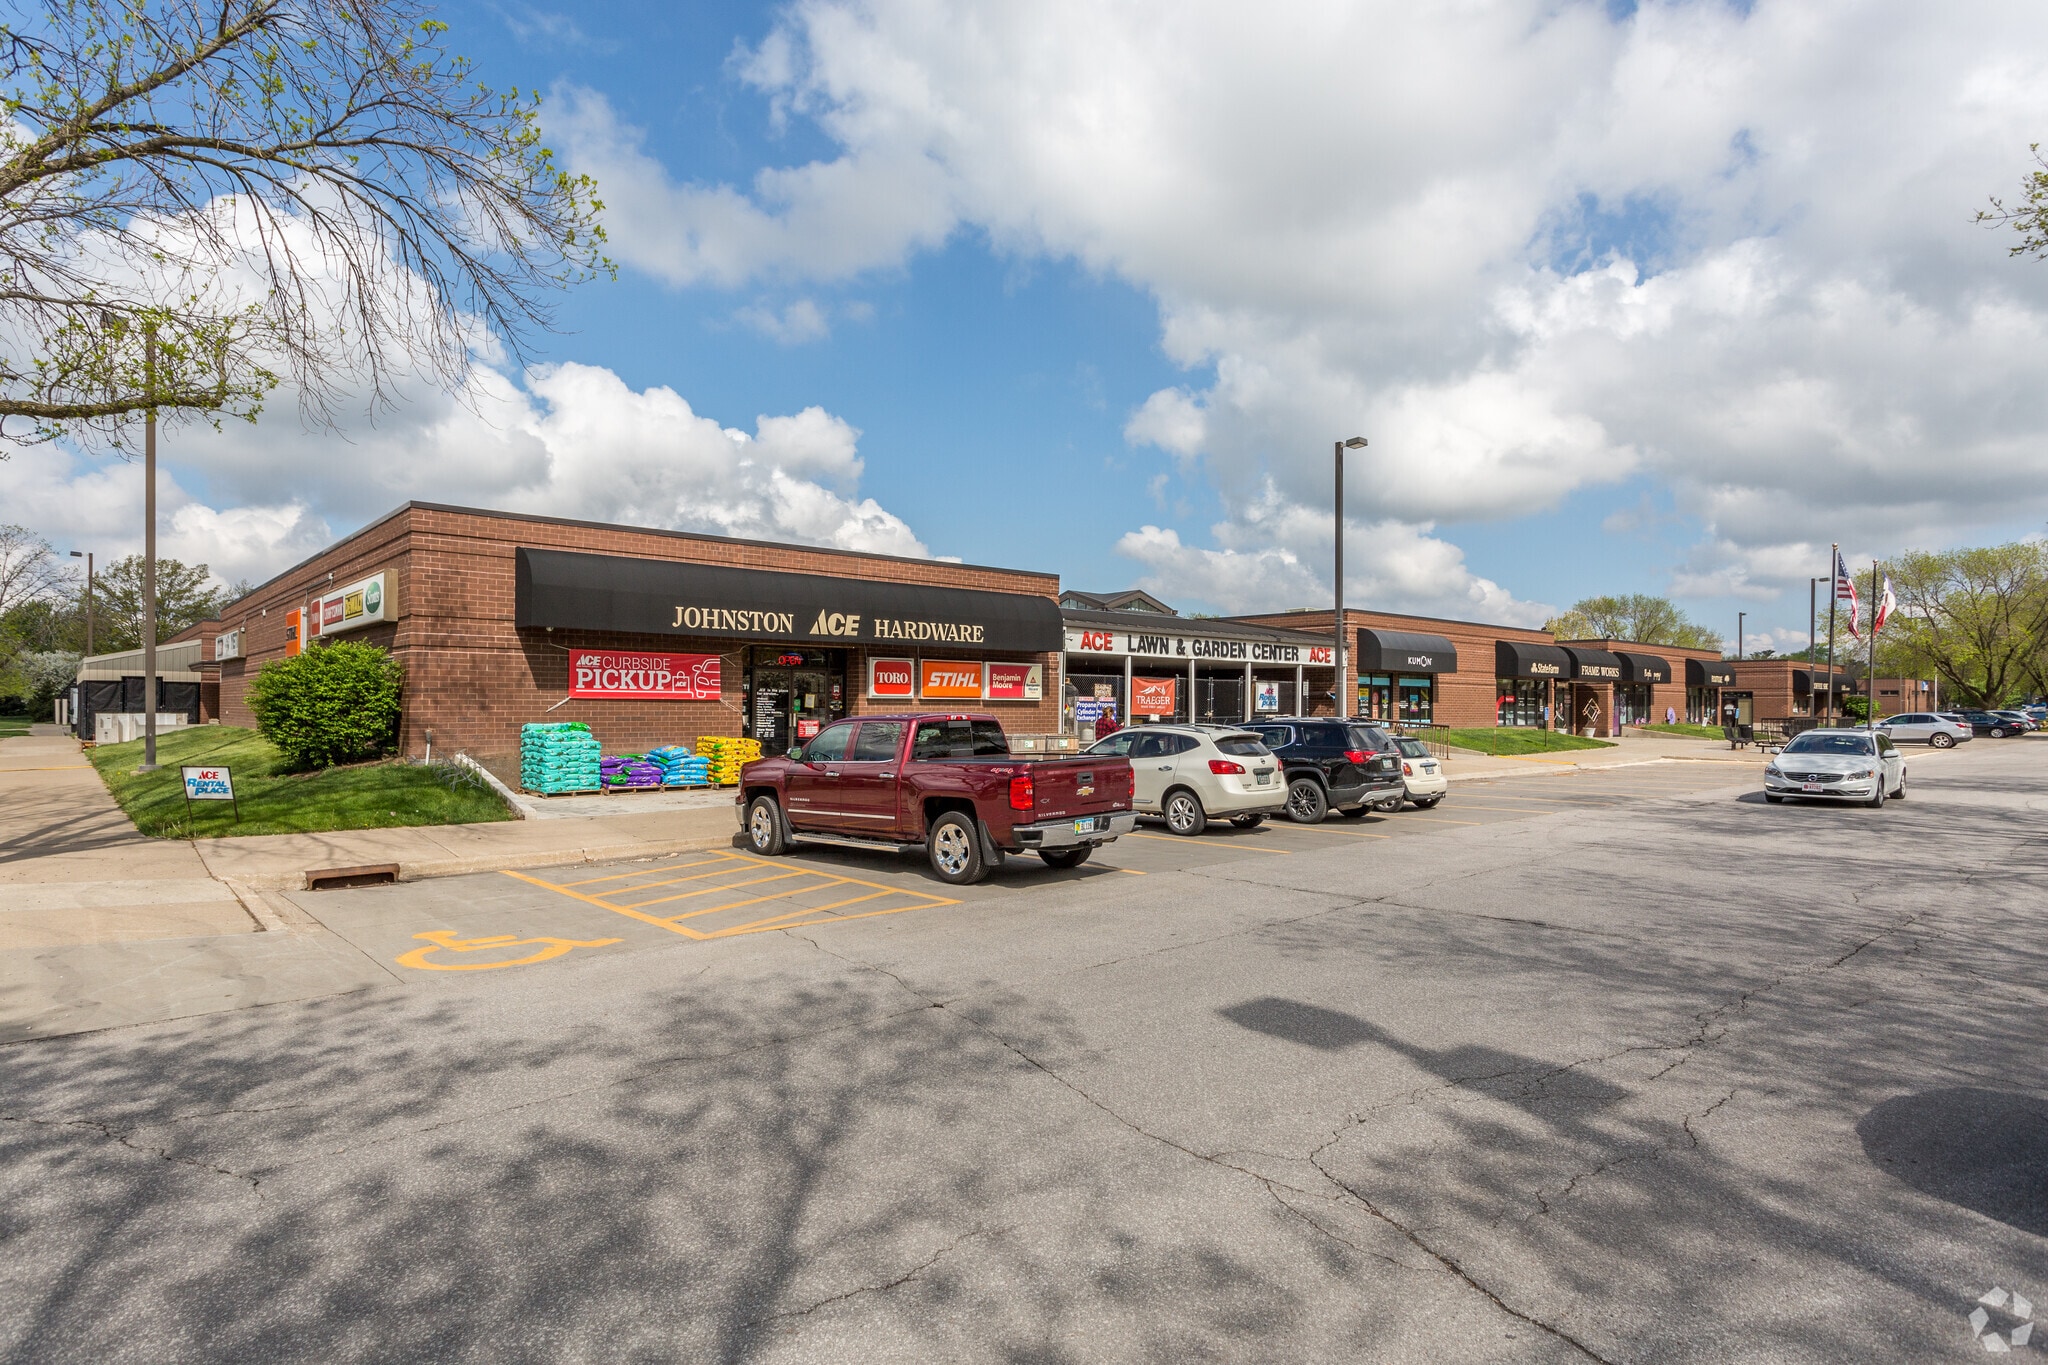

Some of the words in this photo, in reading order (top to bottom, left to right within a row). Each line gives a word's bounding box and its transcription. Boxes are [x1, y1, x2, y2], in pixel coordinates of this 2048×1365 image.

[672, 606, 794, 634] JOHNSTON
[809, 608, 861, 637] ACE
[873, 619, 985, 643] HARDWARE
[1080, 630, 1113, 651] ACE
[1128, 634, 1170, 655] LAWN
[1176, 638, 1186, 656] &
[1192, 639, 1247, 659] GARDEN
[1252, 643, 1299, 662] CENTER
[1309, 646, 1331, 664] ACE
[576, 653, 601, 666] ACE
[602, 656, 671, 671] CURBSIDE
[778, 655, 802, 665] OPEN
[1407, 655, 1432, 667] KUMON
[876, 671, 909, 684] TORO
[1581, 665, 1600, 677] FRAME
[1600, 666, 1620, 678] WORKS
[575, 668, 672, 690] PICKUP
[928, 671, 979, 687] STIHL
[992, 673, 1021, 683] Benjamin
[992, 681, 1013, 689] Moore
[1076, 701, 1097, 709] Propane
[1135, 695, 1171, 705] TRAEGER
[198, 769, 219, 780] ACE
[1038, 810, 1066, 818] SILVERADO
